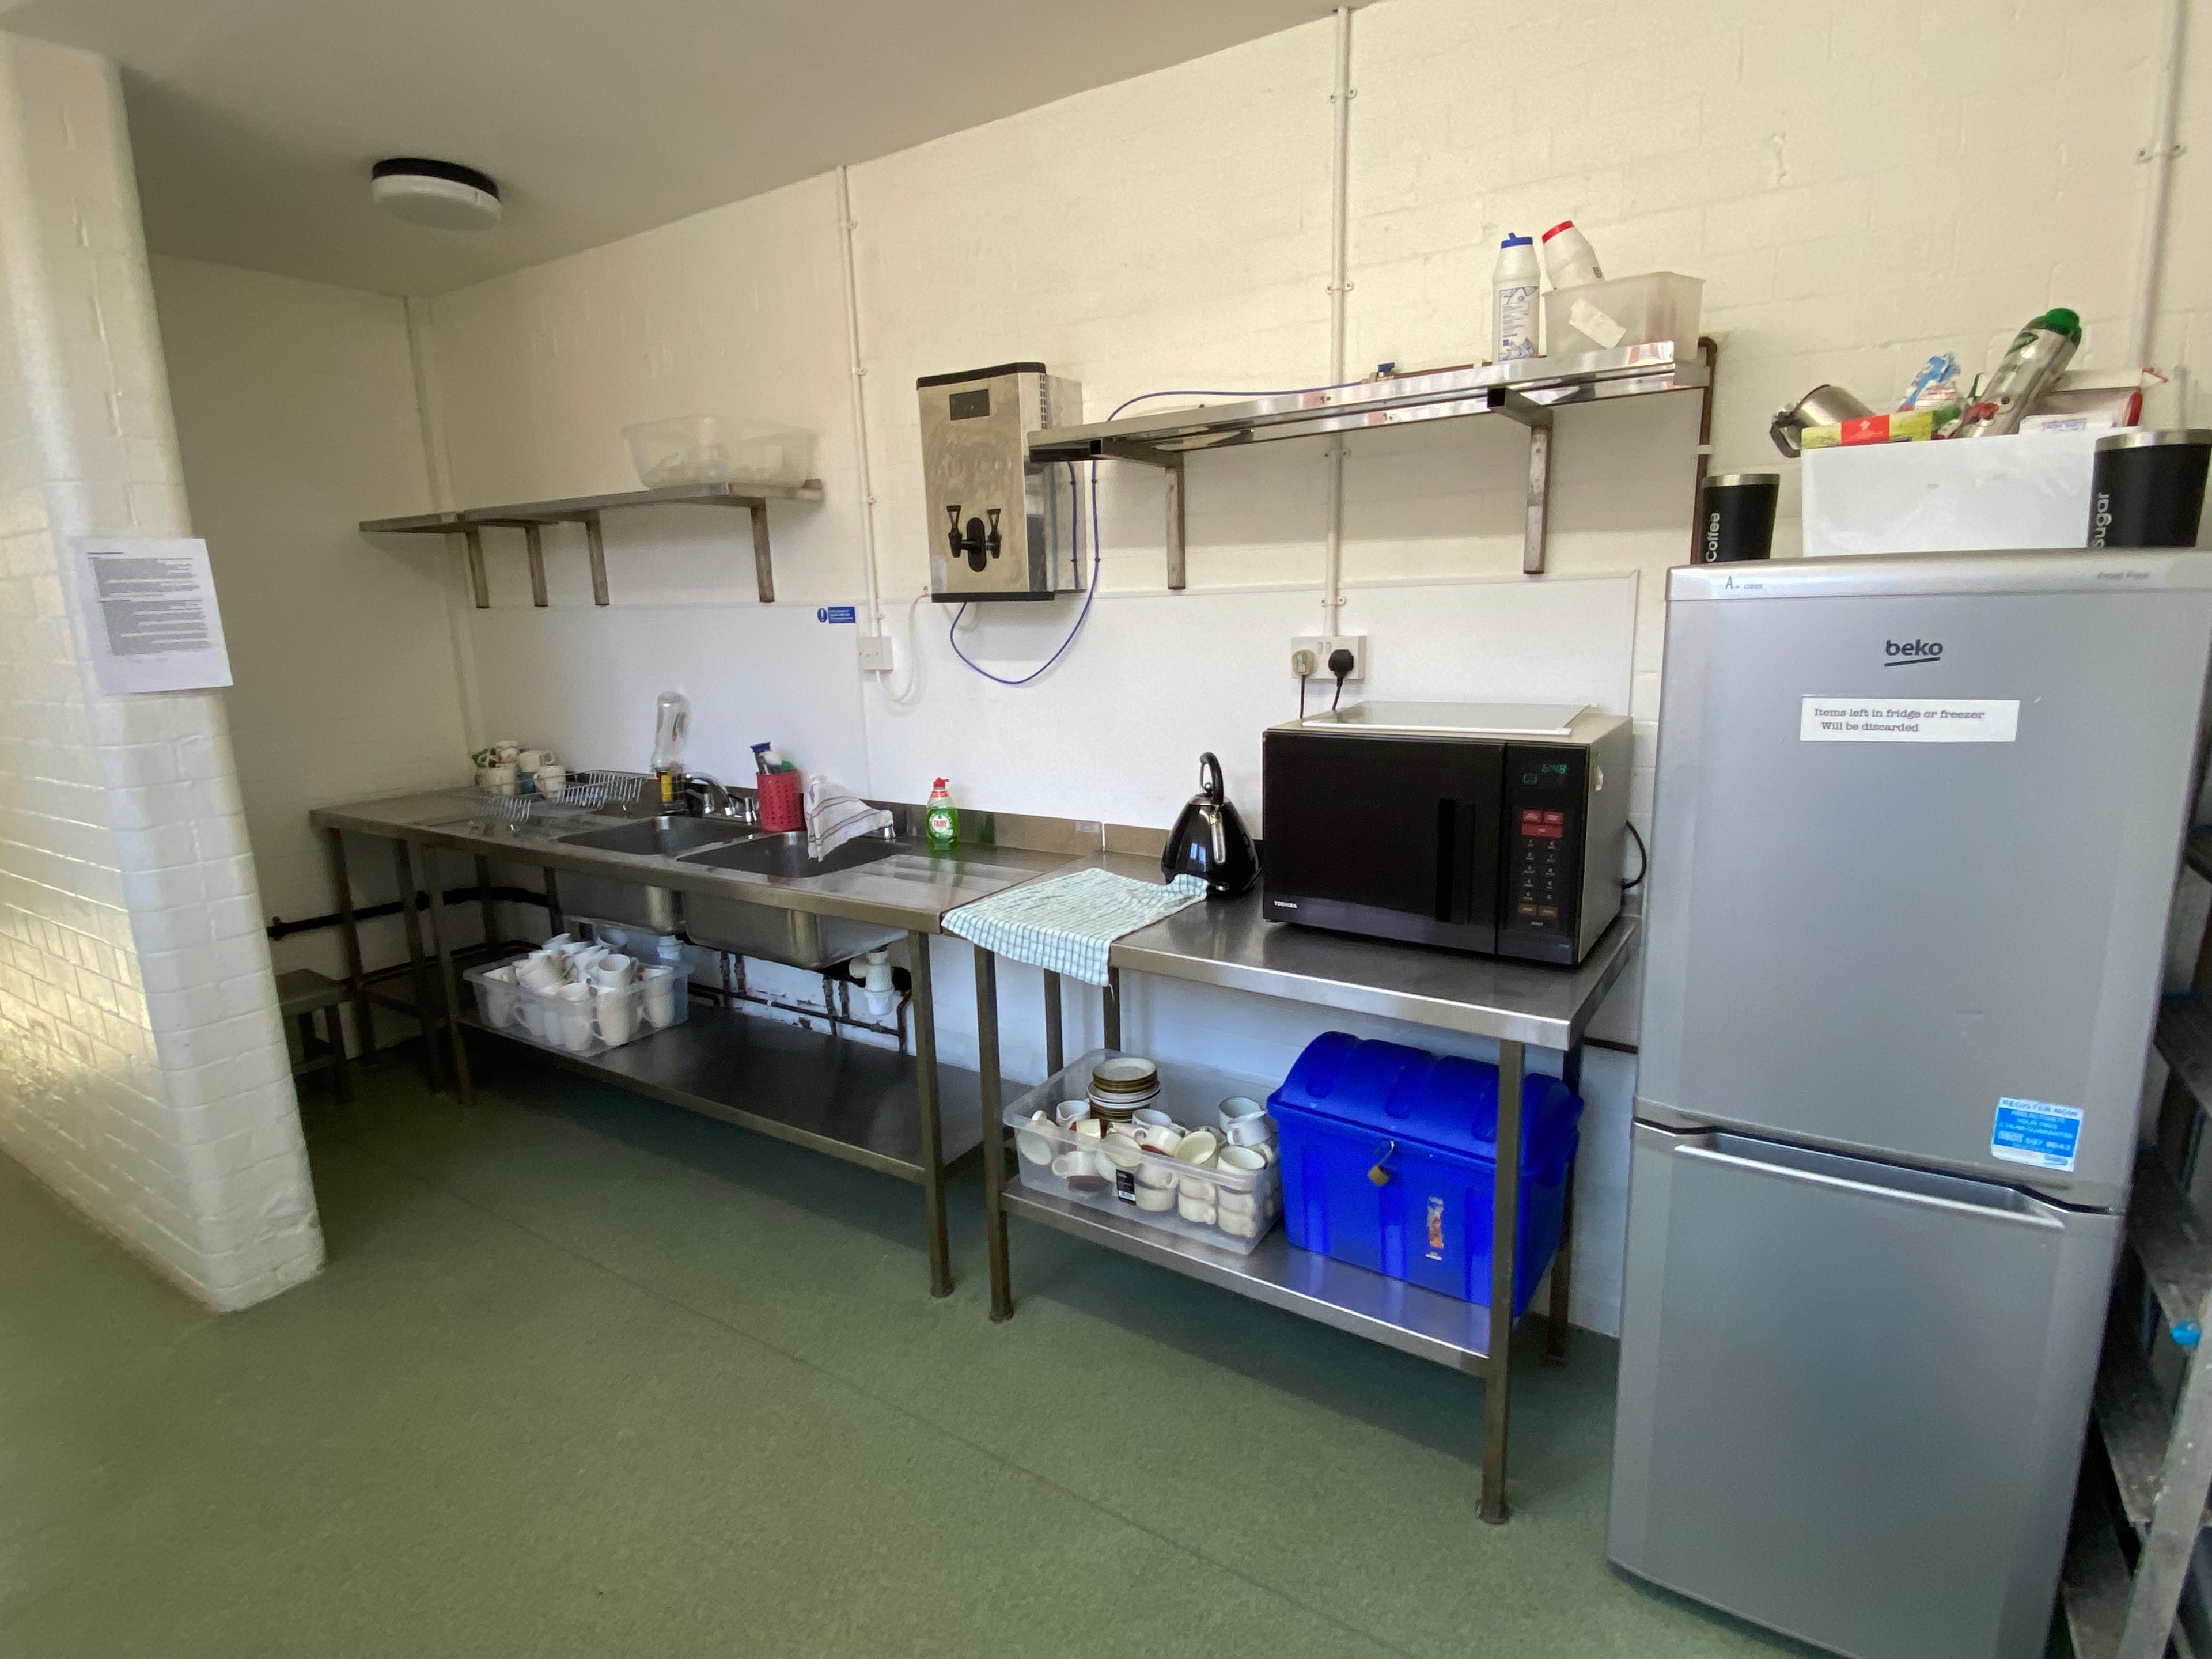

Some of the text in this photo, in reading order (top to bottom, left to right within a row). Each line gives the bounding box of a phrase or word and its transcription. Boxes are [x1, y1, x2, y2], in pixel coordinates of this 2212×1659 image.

[1705, 512, 1721, 562] Coffee
[1885, 639, 1944, 656] beko
[1815, 709, 1846, 717] Items
[1849, 709, 1869, 717] left
[1872, 709, 1883, 718] in
[1886, 709, 1921, 719] fridge
[1940, 710, 1985, 719] freezer
[1821, 722, 1919, 732] Will be discarded
[1274, 900, 1297, 909] TOSHIBA
